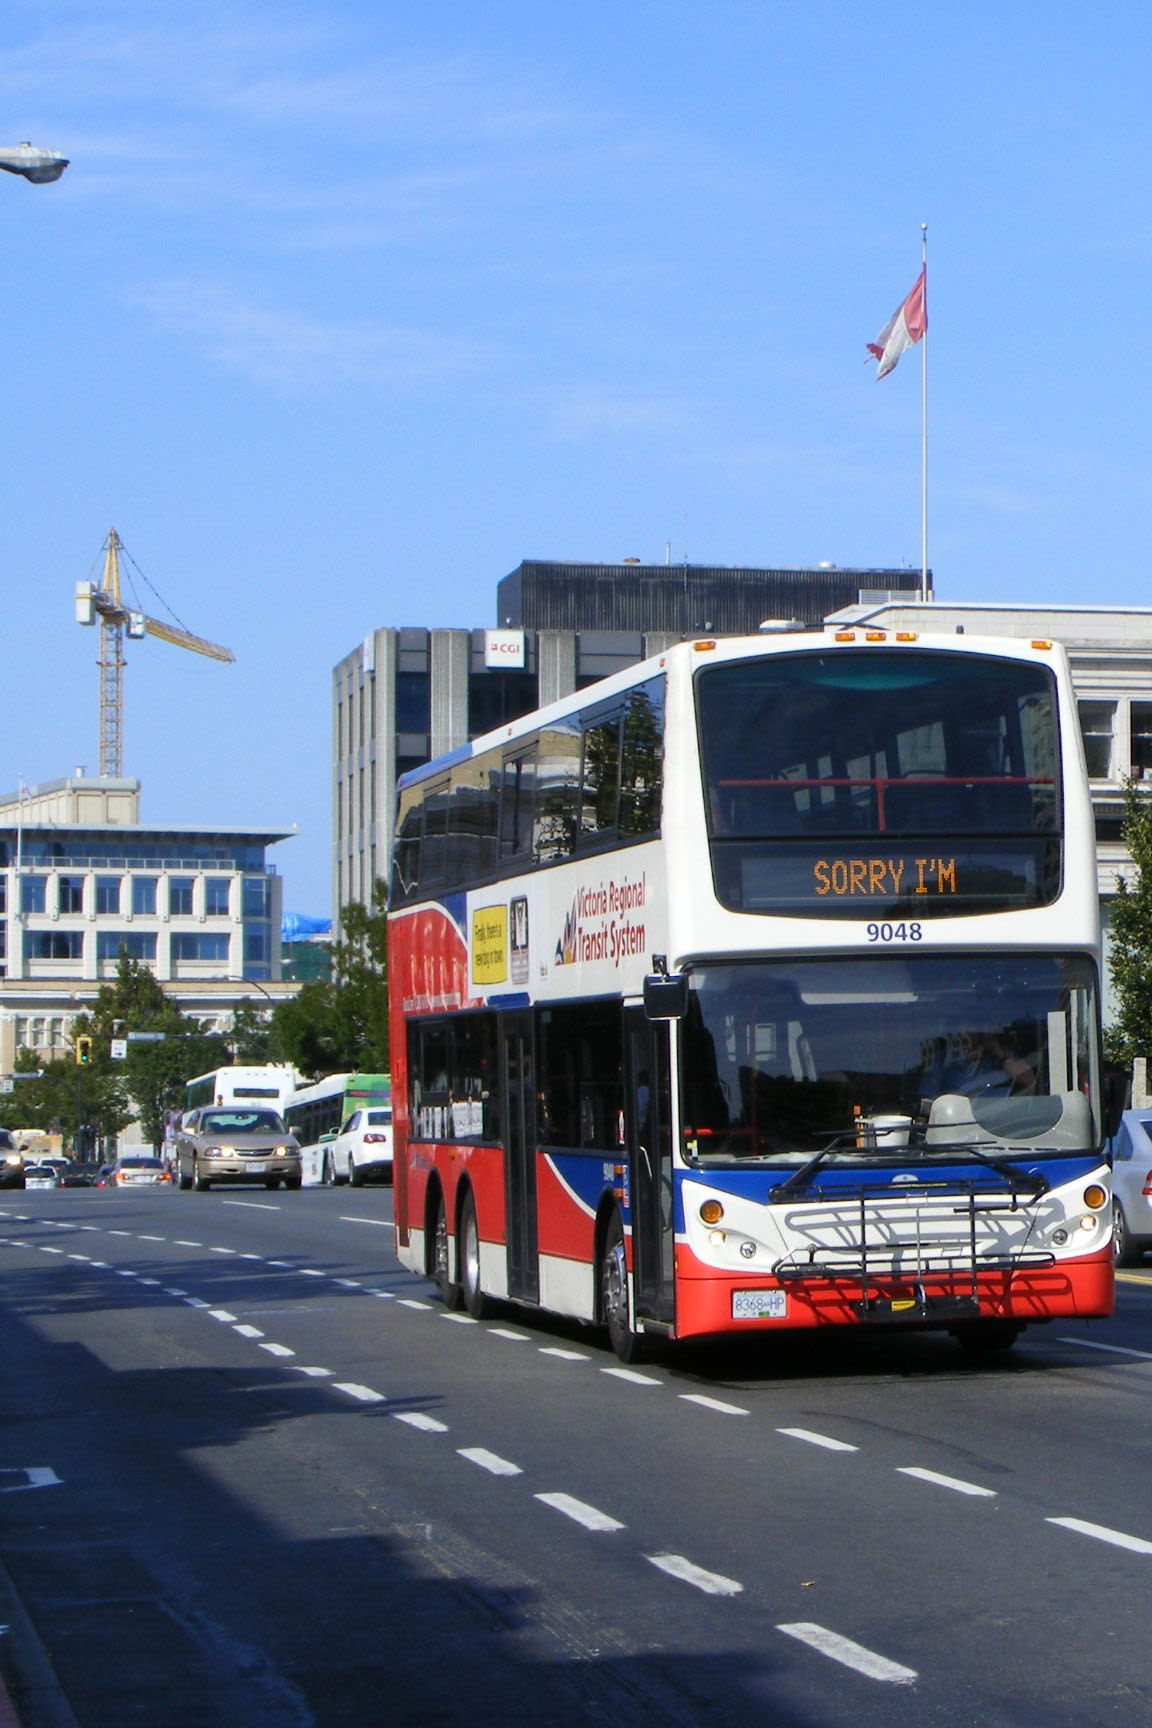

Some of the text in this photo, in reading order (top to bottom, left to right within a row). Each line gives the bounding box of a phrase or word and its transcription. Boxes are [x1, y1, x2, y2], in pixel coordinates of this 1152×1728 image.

[500, 643, 520, 654] CGI
[577, 871, 646, 919] Victoria Regional
[813, 858, 956, 895] SORRY I'M
[577, 919, 645, 968] Transit System
[866, 922, 922, 942] 9048
